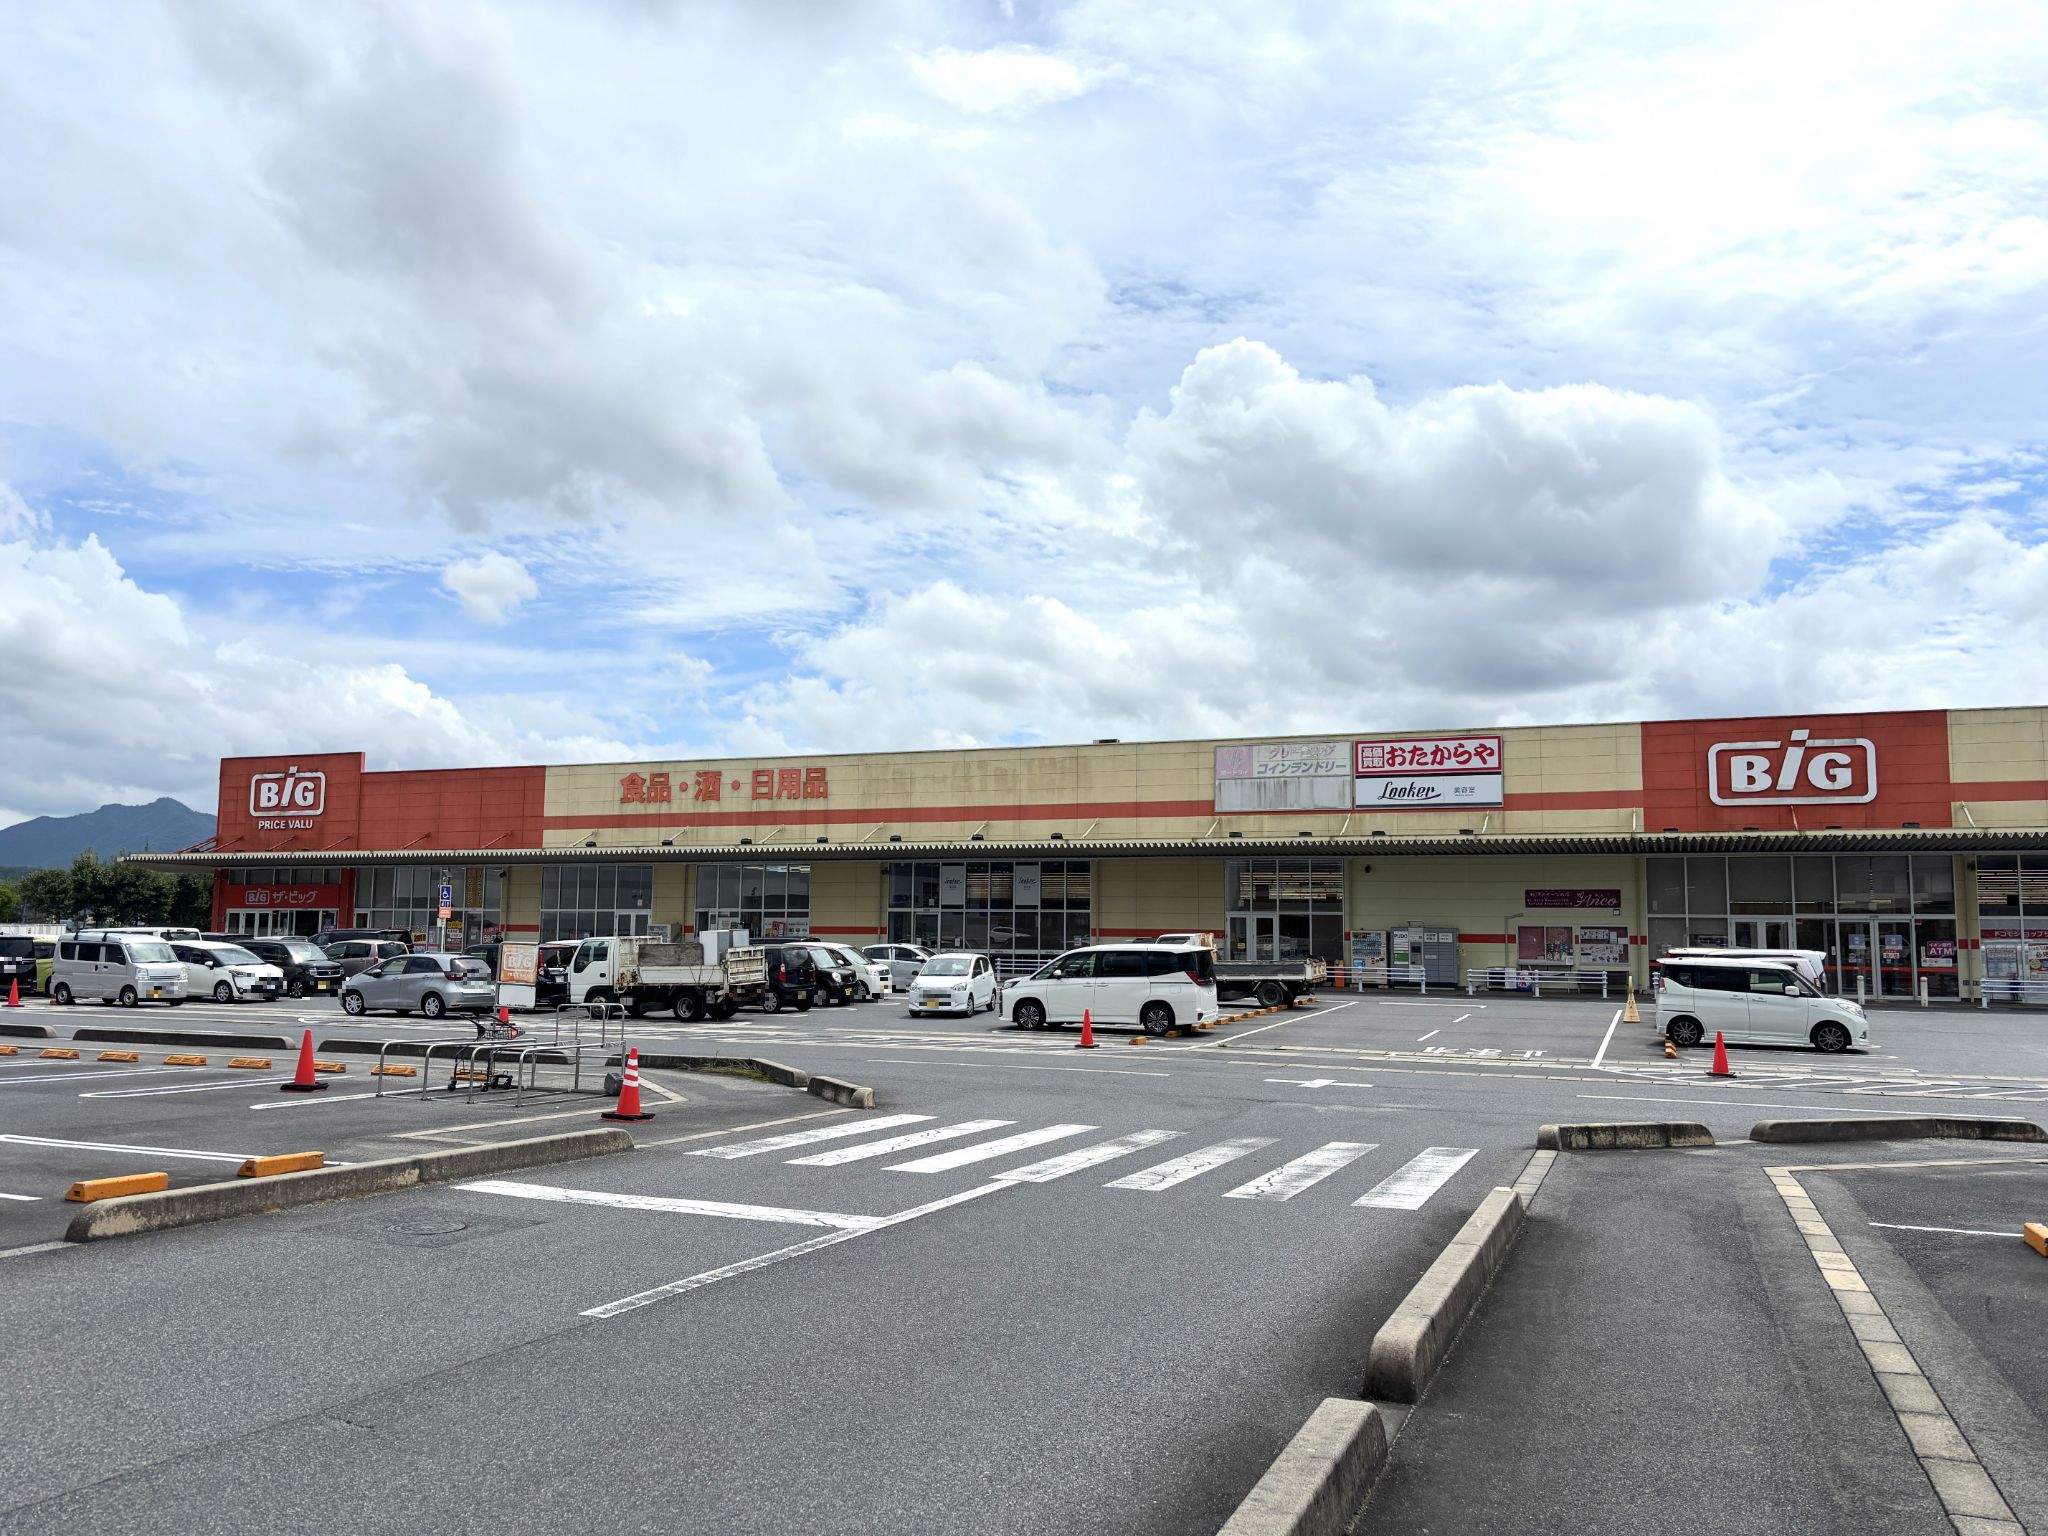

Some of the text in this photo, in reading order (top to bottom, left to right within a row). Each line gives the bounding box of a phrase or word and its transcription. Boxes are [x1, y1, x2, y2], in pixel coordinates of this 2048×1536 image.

[1385, 742, 1496, 768] おたからや
[1256, 761, 1348, 775] コインランドリー
[619, 768, 829, 804] 食品・酒・日用品
[1377, 781, 1442, 800] Looker
[258, 819, 313, 830] PRICE VALU
[272, 891, 318, 903] ザ・ビッグ
[1929, 947, 1953, 956] ATM
